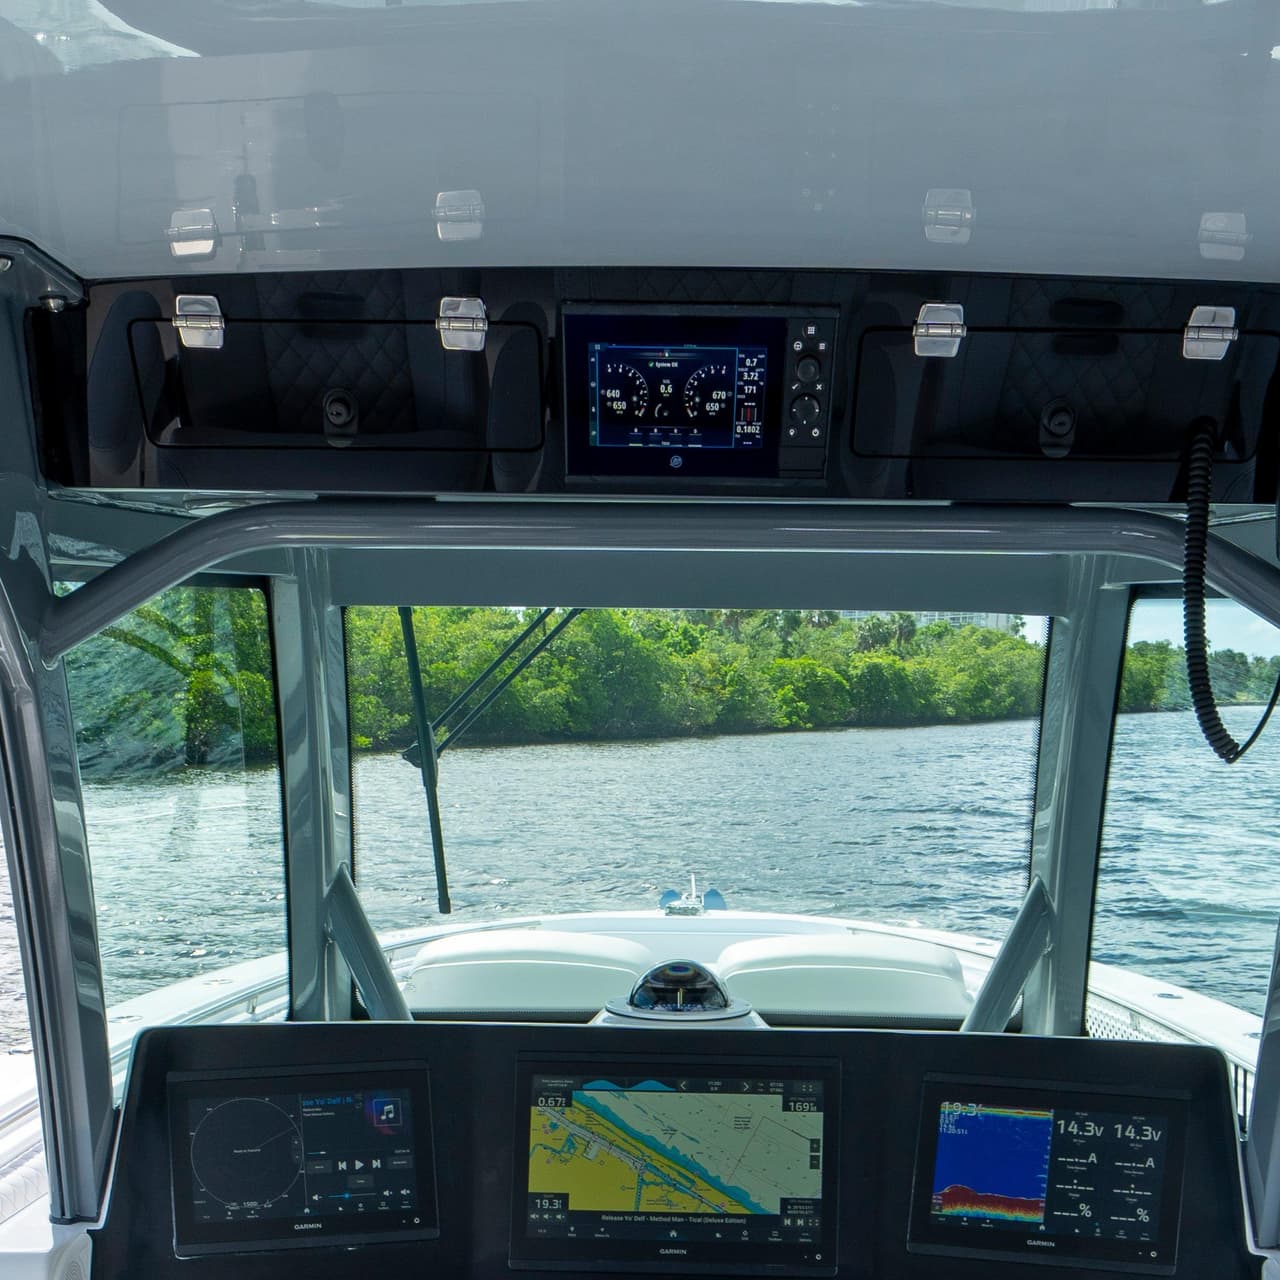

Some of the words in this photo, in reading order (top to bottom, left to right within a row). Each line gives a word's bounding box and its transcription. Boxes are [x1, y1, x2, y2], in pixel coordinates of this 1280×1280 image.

[745, 358, 758, 367] 0.7
[742, 372, 759, 381] 3.72
[660, 384, 673, 393] 0.6
[744, 386, 757, 394] 171
[606, 389, 620, 398] 640
[712, 391, 726, 400] 670
[612, 401, 627, 410] 650
[705, 402, 719, 411] 650
[736, 425, 761, 433] 0.1802
[293, 1223, 323, 1231] GARMIN
[1026, 1239, 1056, 1248] GARMIN
